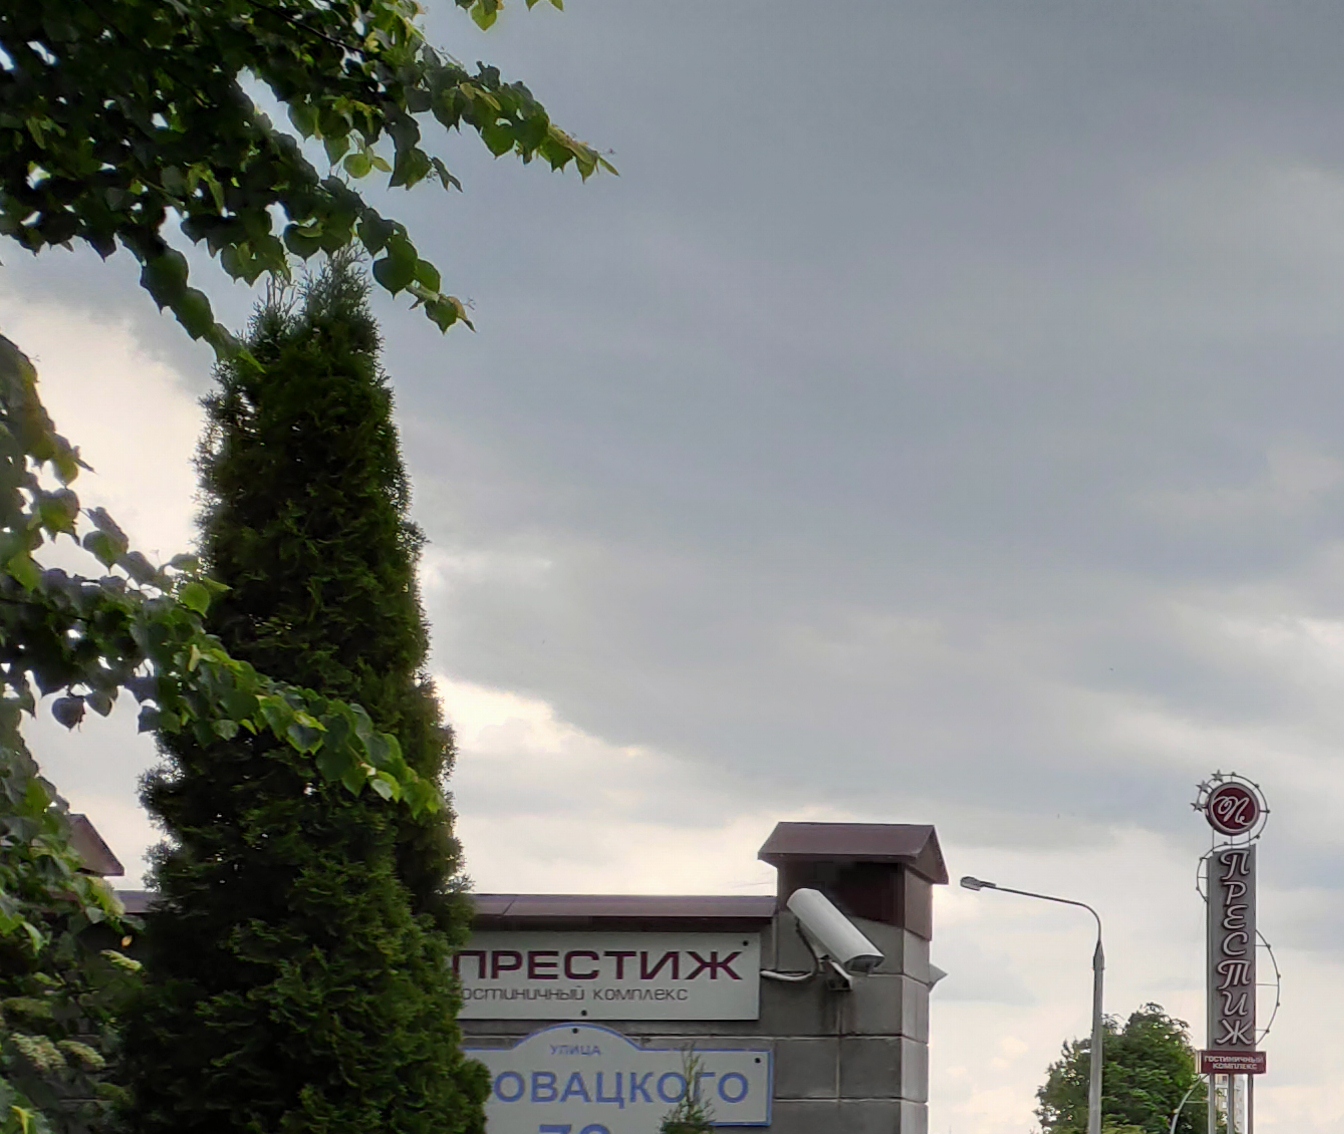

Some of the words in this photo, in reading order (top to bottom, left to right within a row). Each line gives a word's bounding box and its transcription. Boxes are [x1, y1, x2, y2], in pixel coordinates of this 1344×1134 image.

[1216, 850, 1254, 1045] ПРЕСТИЖ
[453, 950, 743, 980] ПРЕСТИЖ
[461, 985, 585, 1001] остиничный
[592, 988, 689, 1001] комплекс
[549, 1044, 602, 1055] УЛИЦА
[492, 1070, 750, 1108] ОВАЦКОГО
